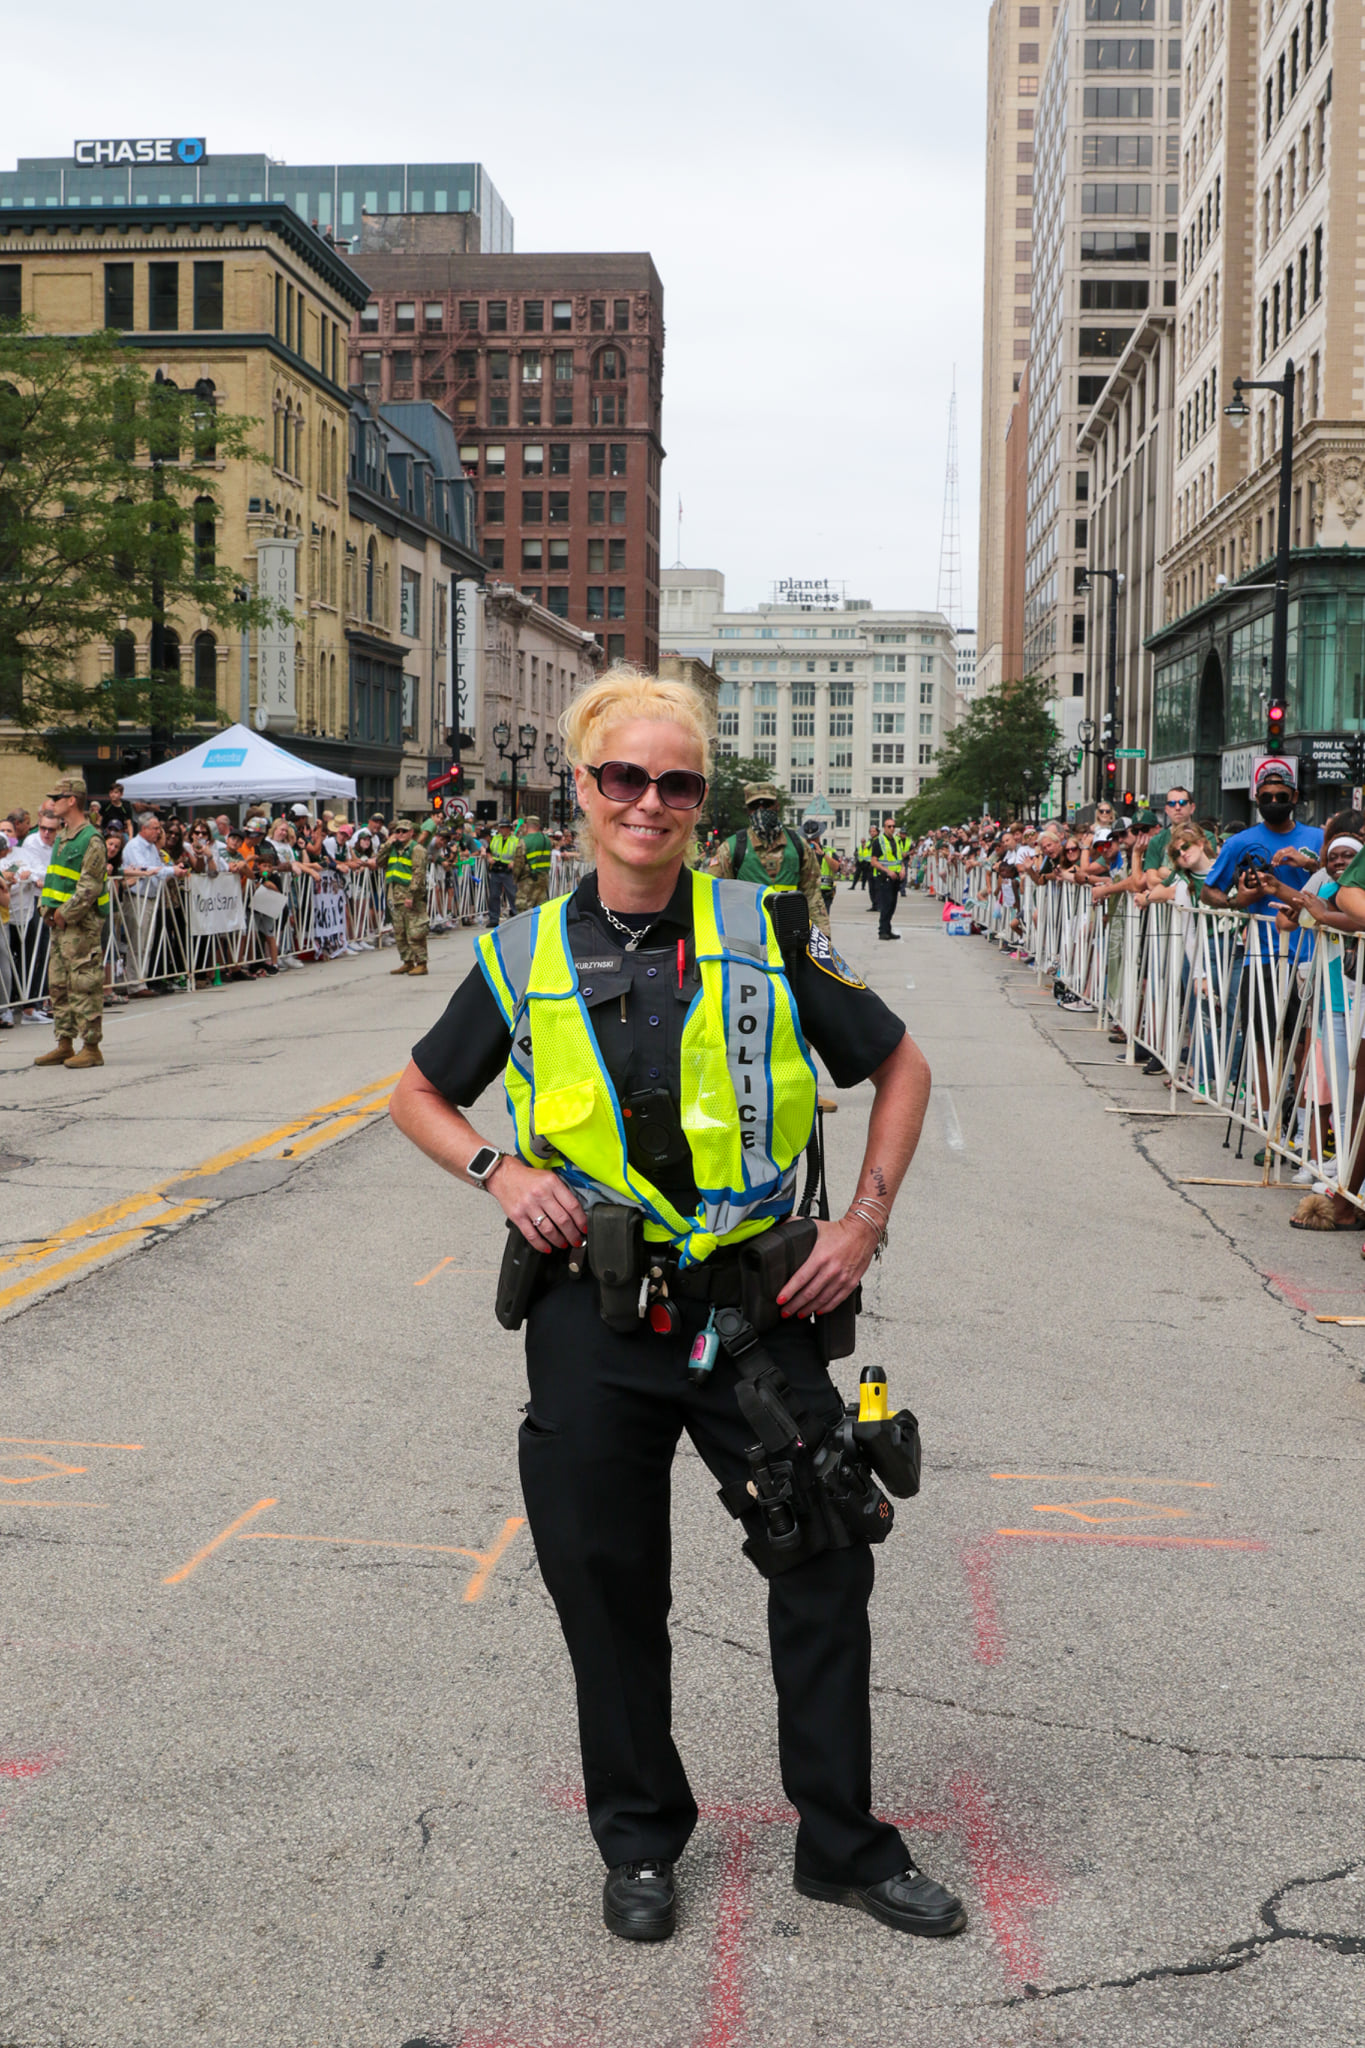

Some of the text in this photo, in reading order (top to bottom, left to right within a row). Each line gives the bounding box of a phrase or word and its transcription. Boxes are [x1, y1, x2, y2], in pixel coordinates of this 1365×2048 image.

[76, 140, 173, 162] CHASE
[779, 577, 828, 592] planet
[786, 591, 840, 602] fitness
[456, 588, 467, 645] EAST
[278, 550, 287, 703] JOHNON BANK
[457, 664, 468, 720] TOWN
[1313, 741, 1333, 750] NOW
[1312, 752, 1342, 760] OFFICE
[575, 961, 614, 970] KURZYNSKI
[737, 984, 758, 1150] POLICE
